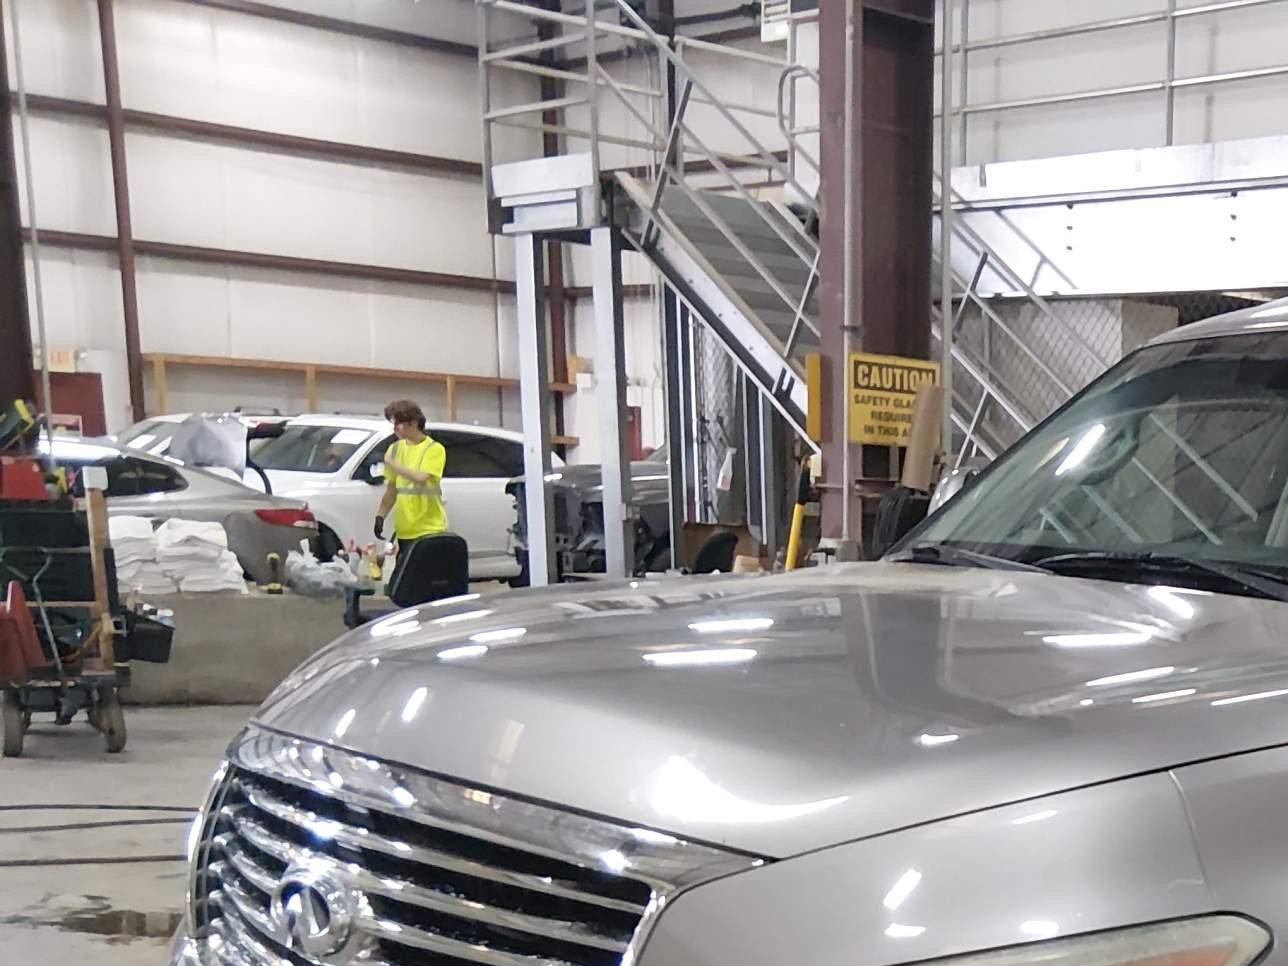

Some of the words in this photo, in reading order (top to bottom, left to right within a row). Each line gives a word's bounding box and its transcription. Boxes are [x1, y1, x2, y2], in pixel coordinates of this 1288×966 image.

[857, 364, 933, 392] CAUTION
[854, 394, 890, 406] SAFETY
[864, 424, 874, 435] IN
[878, 425, 899, 437] THIS
